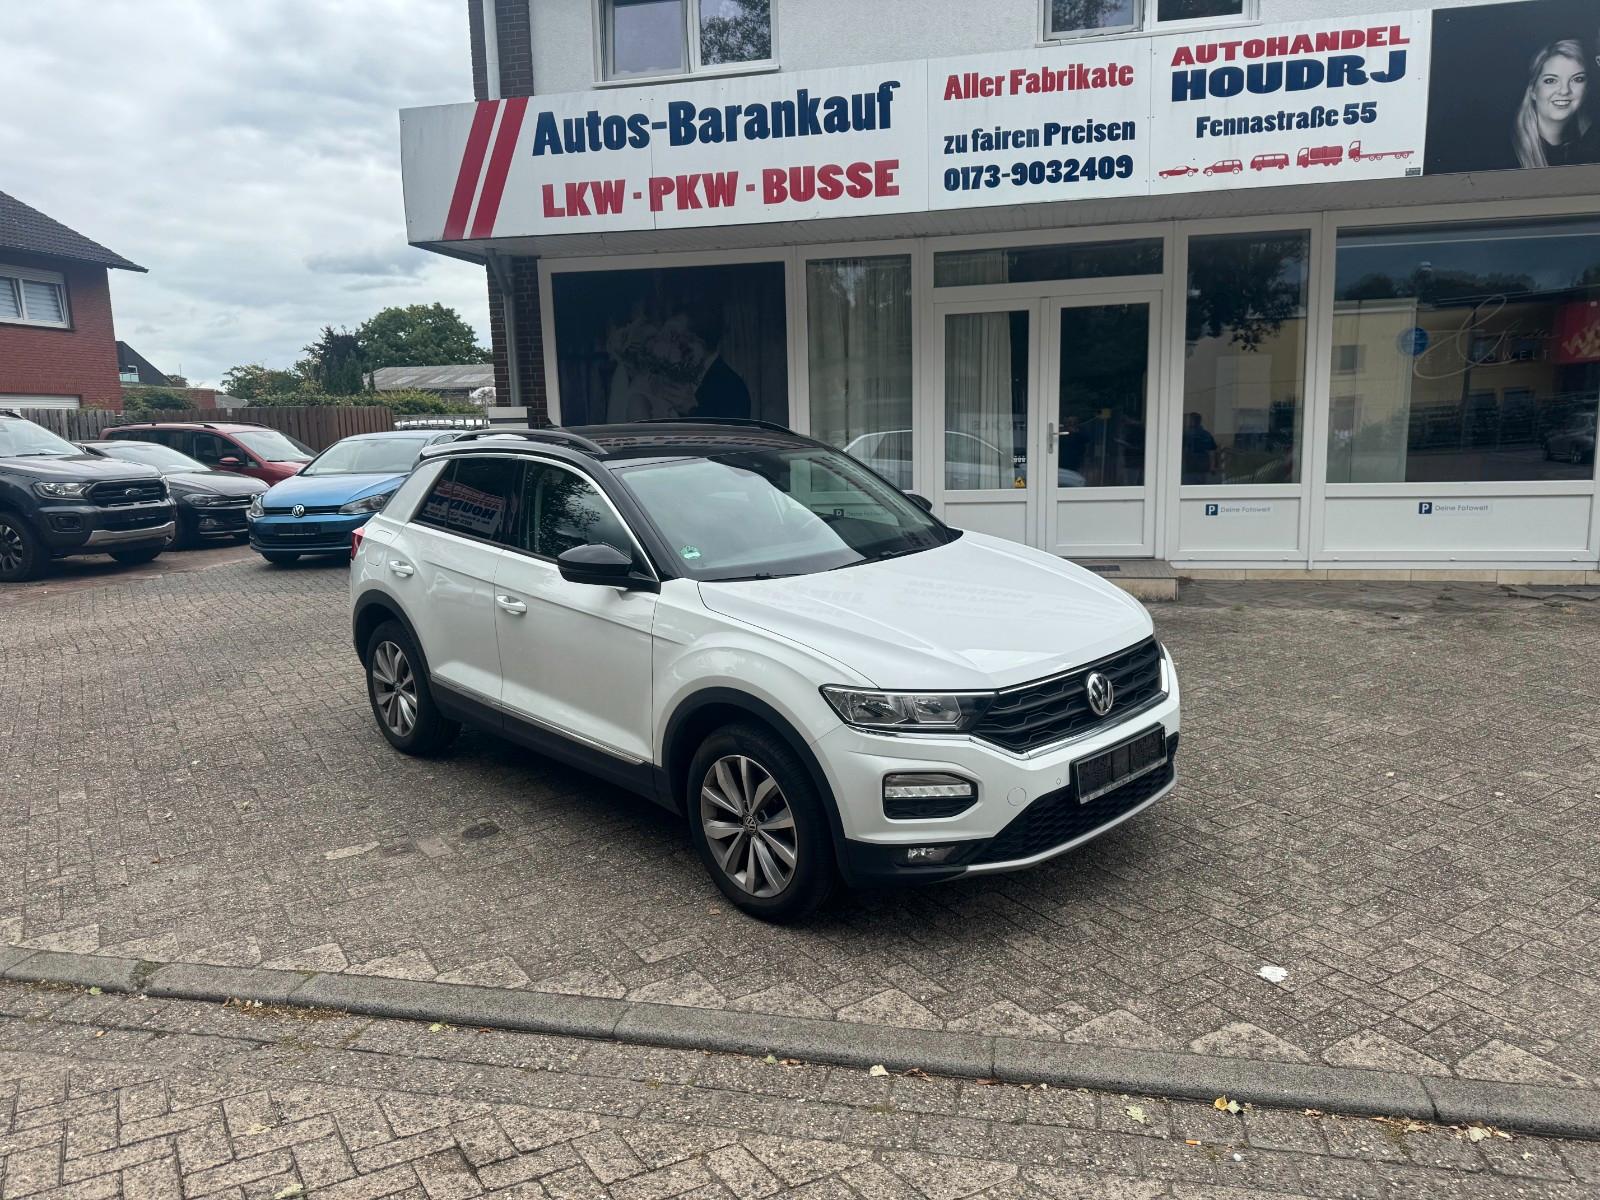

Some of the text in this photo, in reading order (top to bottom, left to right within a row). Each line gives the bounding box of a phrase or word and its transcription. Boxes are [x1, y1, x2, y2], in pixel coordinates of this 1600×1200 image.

[1171, 25, 1410, 67] AUTOHANDEL
[943, 62, 1134, 101] Aller Fabrikate
[1171, 49, 1407, 102] HOUDRJ
[532, 80, 901, 156] Autos-Barankauf
[944, 119, 1136, 155] zu fairen Preisen
[1196, 102, 1377, 139] Fennastraße 55
[944, 154, 1133, 192] 0173-9032409
